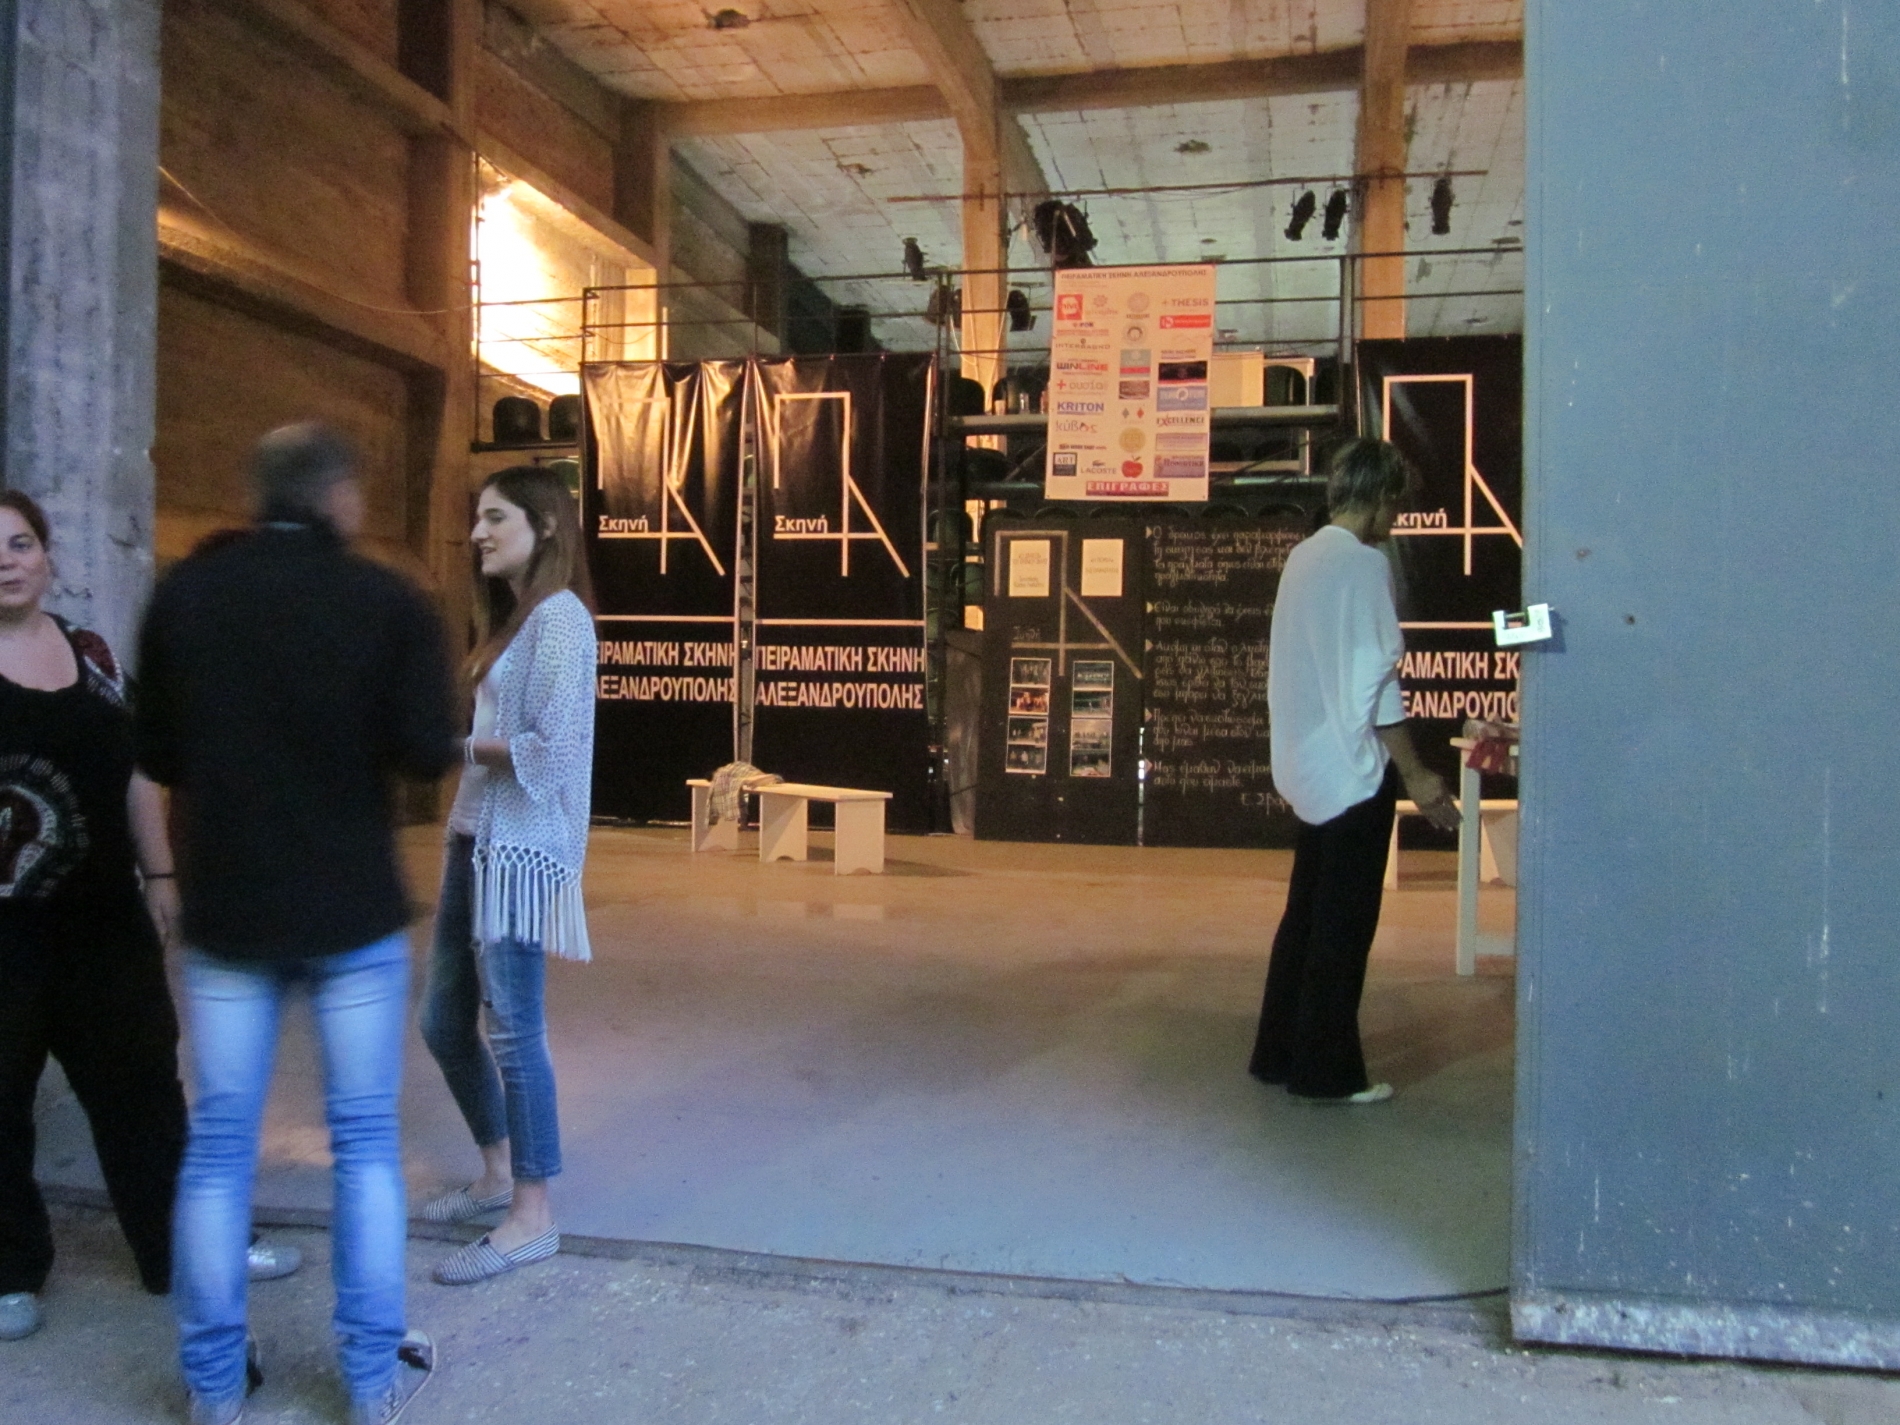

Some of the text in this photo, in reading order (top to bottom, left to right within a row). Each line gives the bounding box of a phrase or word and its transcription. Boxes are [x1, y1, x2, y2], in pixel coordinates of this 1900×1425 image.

[1108, 271, 1132, 279] ΣΚΗΝΗ
[1171, 298, 1209, 307] THESIS
[1056, 362, 1108, 371] WINLINE
[1057, 401, 1104, 412] KRITON
[1156, 414, 1205, 426] EXCELLENCE
[1087, 482, 1168, 492] ΕΠΙΓΡΑΦΕΣ
[598, 514, 649, 533] Σκηνή
[774, 514, 829, 533] Σκηνή
[1393, 507, 1448, 529] κηνή
[684, 642, 736, 667] ΣΚΗΝΗ
[755, 645, 925, 673] ΠΕΙΡΑΜΑΤΙΚΗ ΣΚΗΝΗ
[1396, 651, 1489, 679] ΑΜΑΤΙΚΗ
[755, 681, 924, 710] ΑΛΕΞΑΝΔΡΟΥΠΟΛΗΣ
